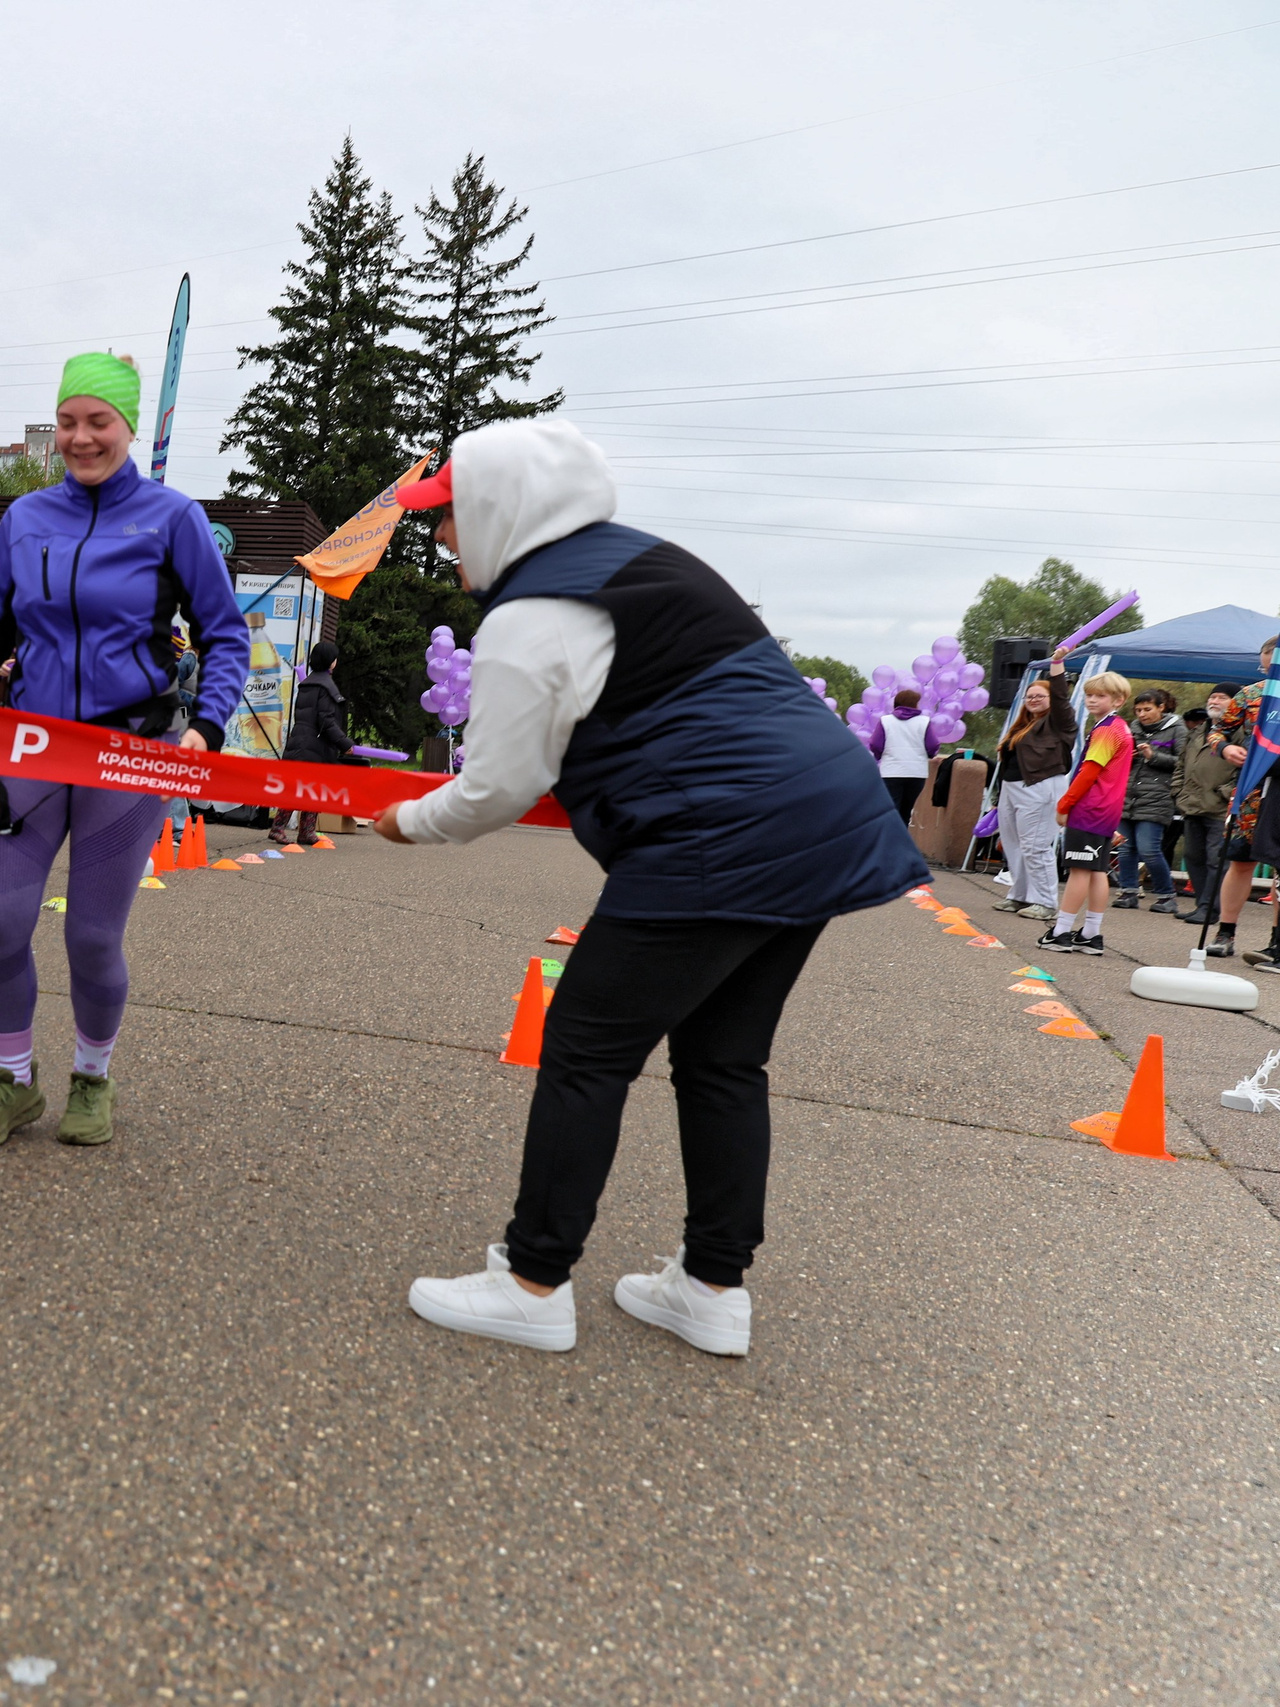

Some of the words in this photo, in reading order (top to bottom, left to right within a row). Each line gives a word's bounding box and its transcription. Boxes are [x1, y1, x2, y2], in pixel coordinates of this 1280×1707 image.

[244, 682, 277, 693] ОЧКАРИ
[97, 751, 212, 781] КРАСНОЯРСК
[100, 769, 202, 795] НАБЕРЕЖНАЯ
[263, 772, 285, 794] 5
[1065, 851, 1094, 861] PUMA
